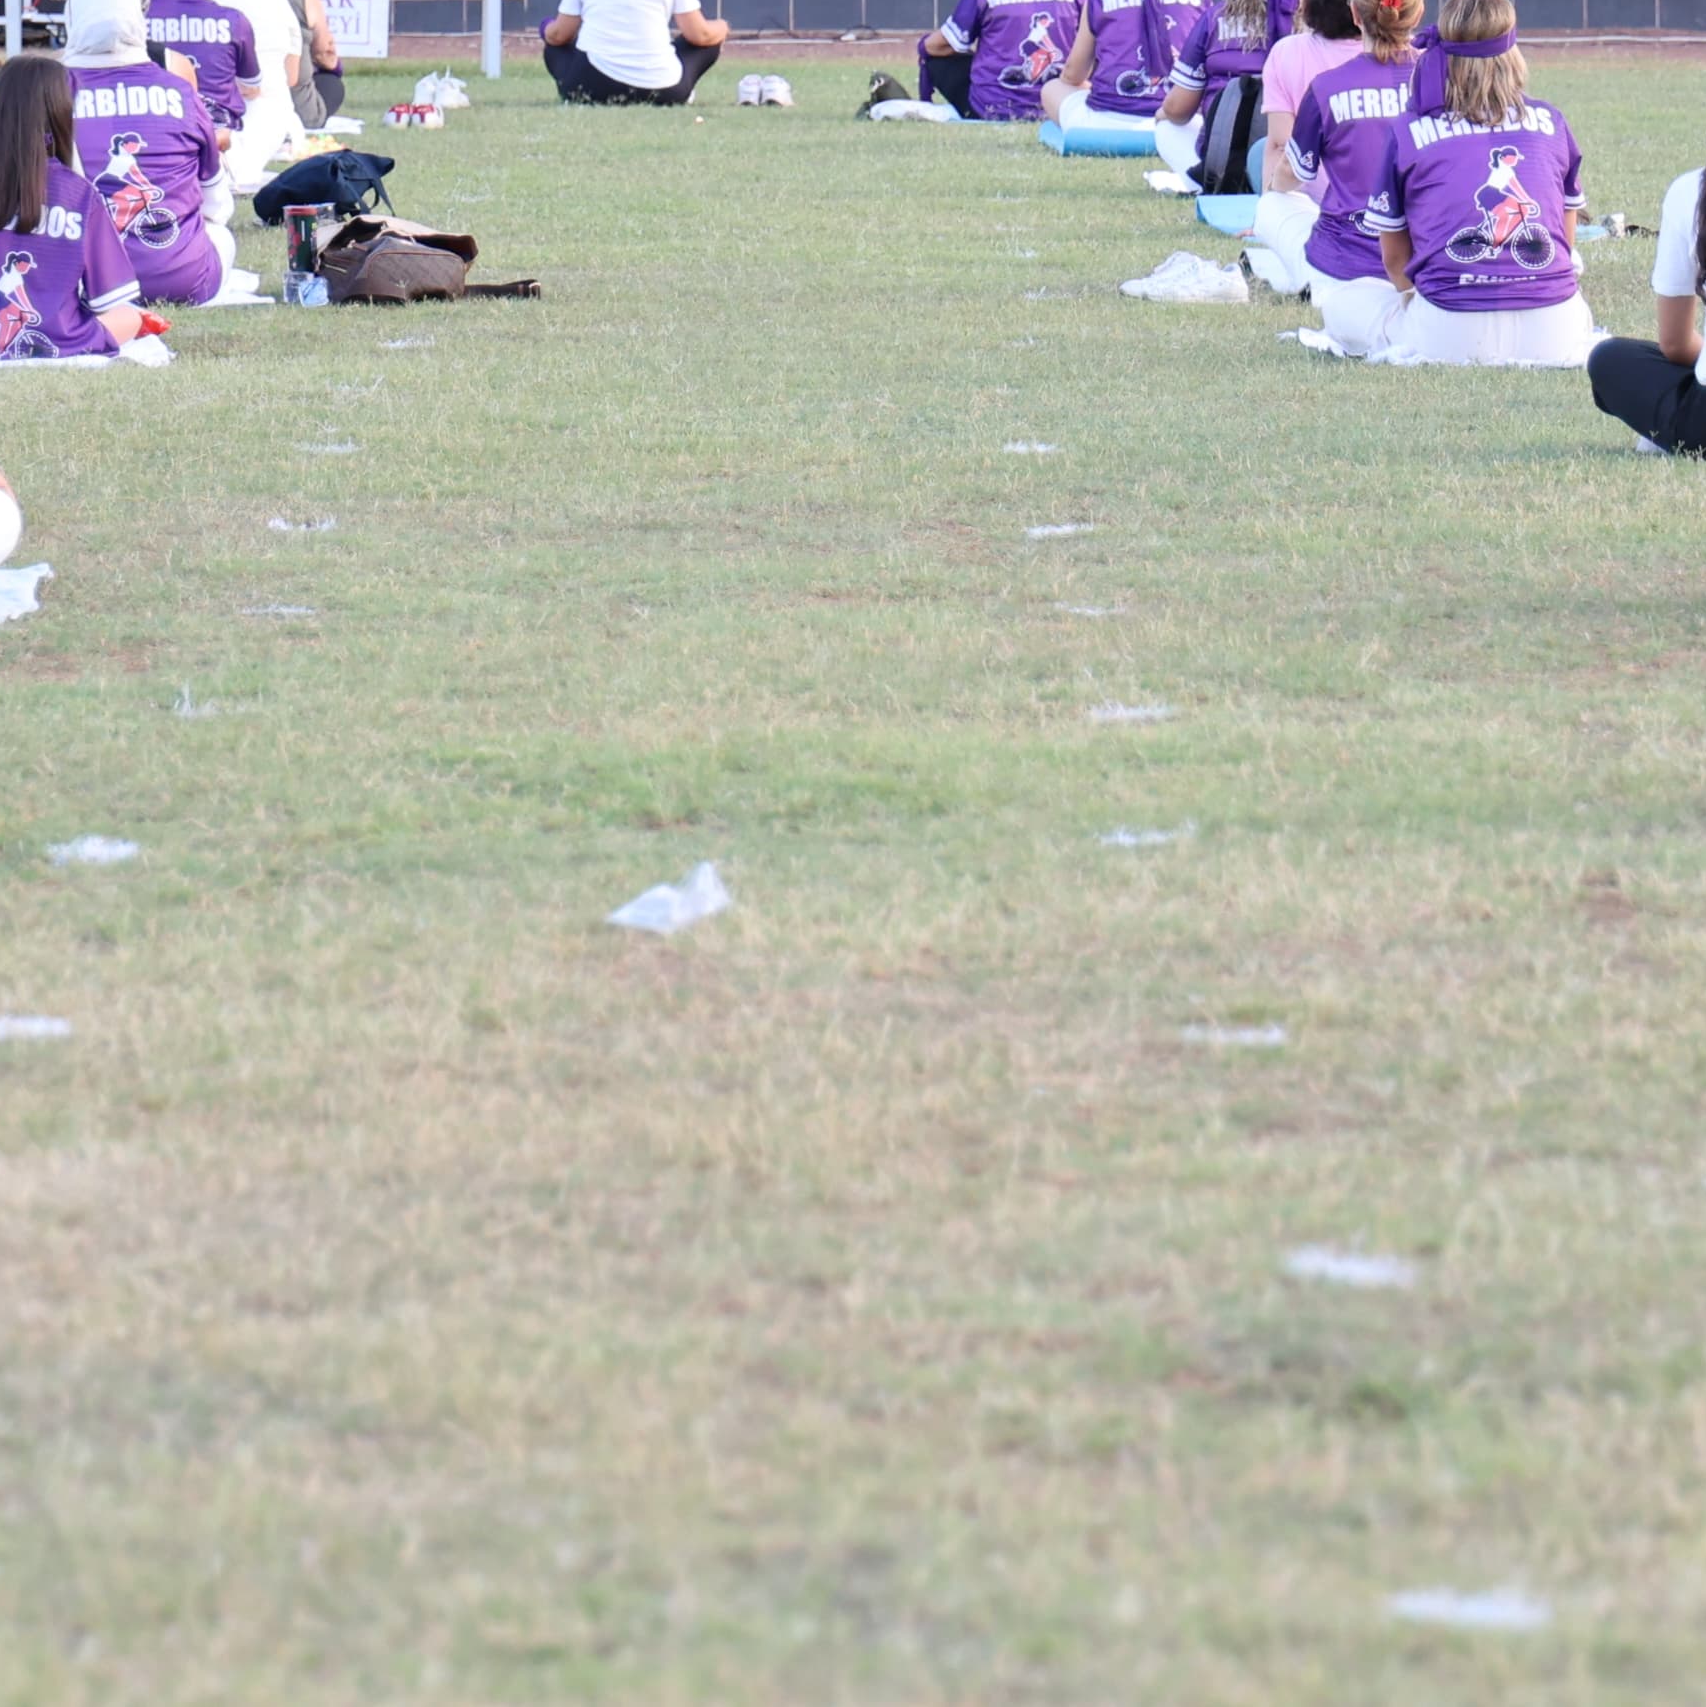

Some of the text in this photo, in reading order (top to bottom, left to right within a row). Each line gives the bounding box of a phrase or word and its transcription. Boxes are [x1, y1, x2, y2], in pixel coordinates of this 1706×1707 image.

[145, 14, 232, 44] ERBİDOS
[73, 82, 184, 119] RBİDOS
[1329, 83, 1408, 124] MERBİ
